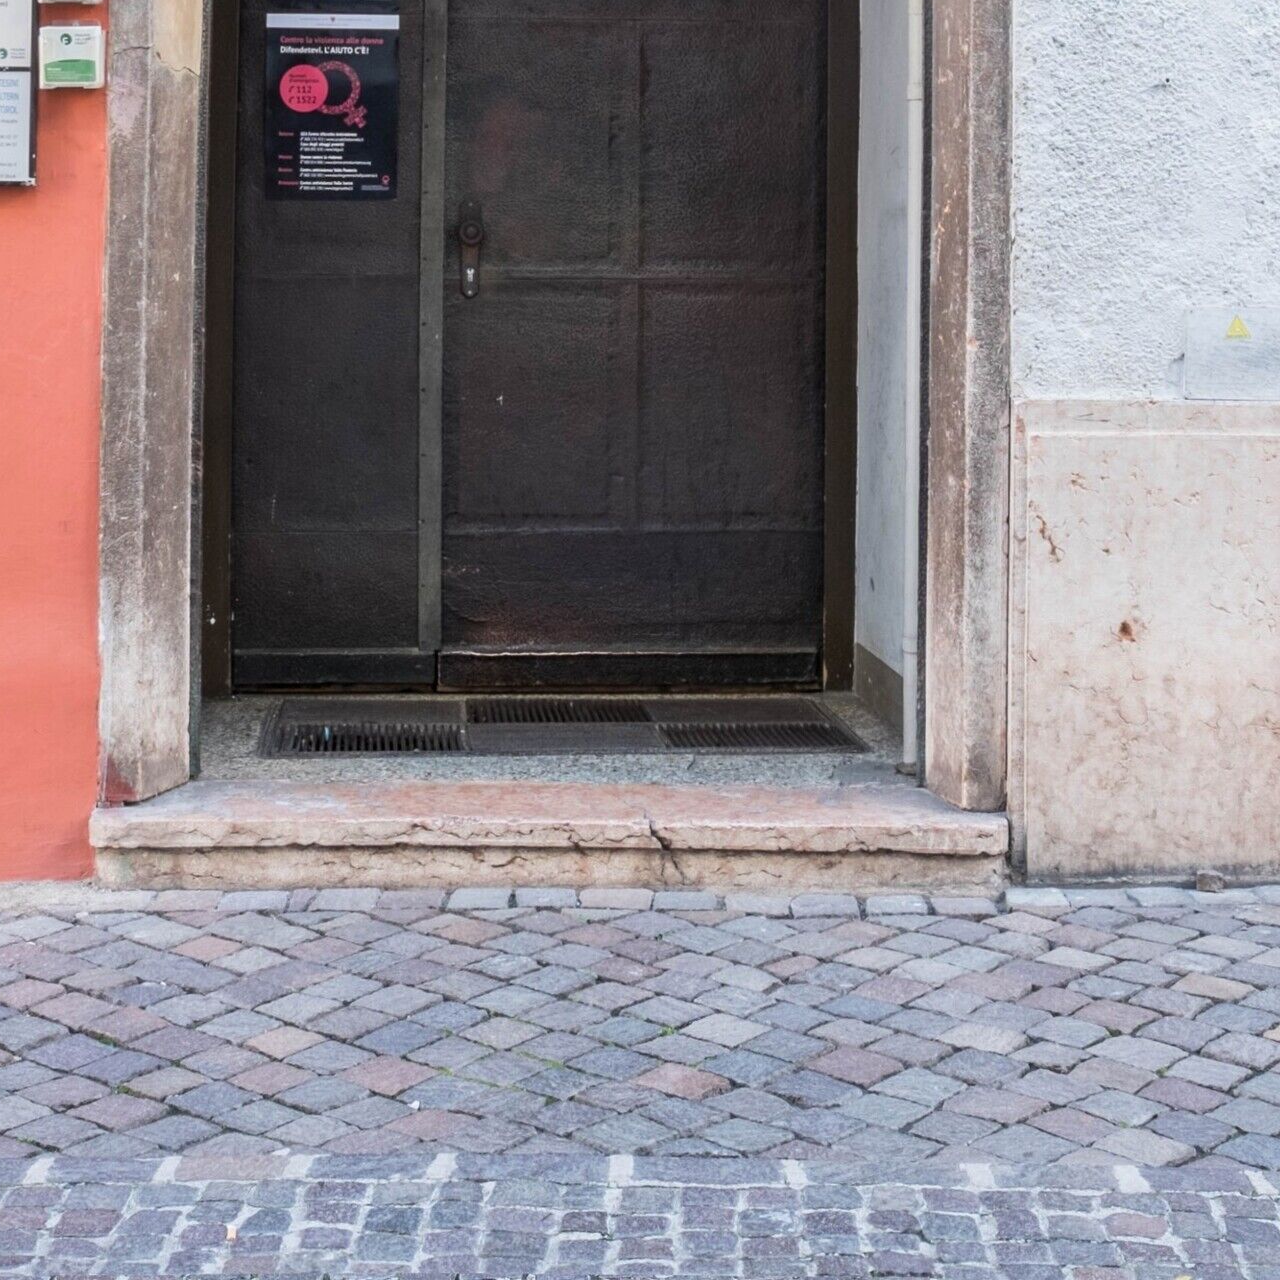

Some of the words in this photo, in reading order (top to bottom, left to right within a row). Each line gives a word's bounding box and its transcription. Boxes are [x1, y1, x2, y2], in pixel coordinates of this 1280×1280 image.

[280, 36, 304, 44] Contro
[305, 36, 313, 44] la
[361, 37, 384, 45] donne
[280, 46, 323, 54] Difendetevi.
[324, 46, 353, 54] L'AIUTO
[296, 86, 312, 94] 112
[296, 96, 317, 104] 1522
